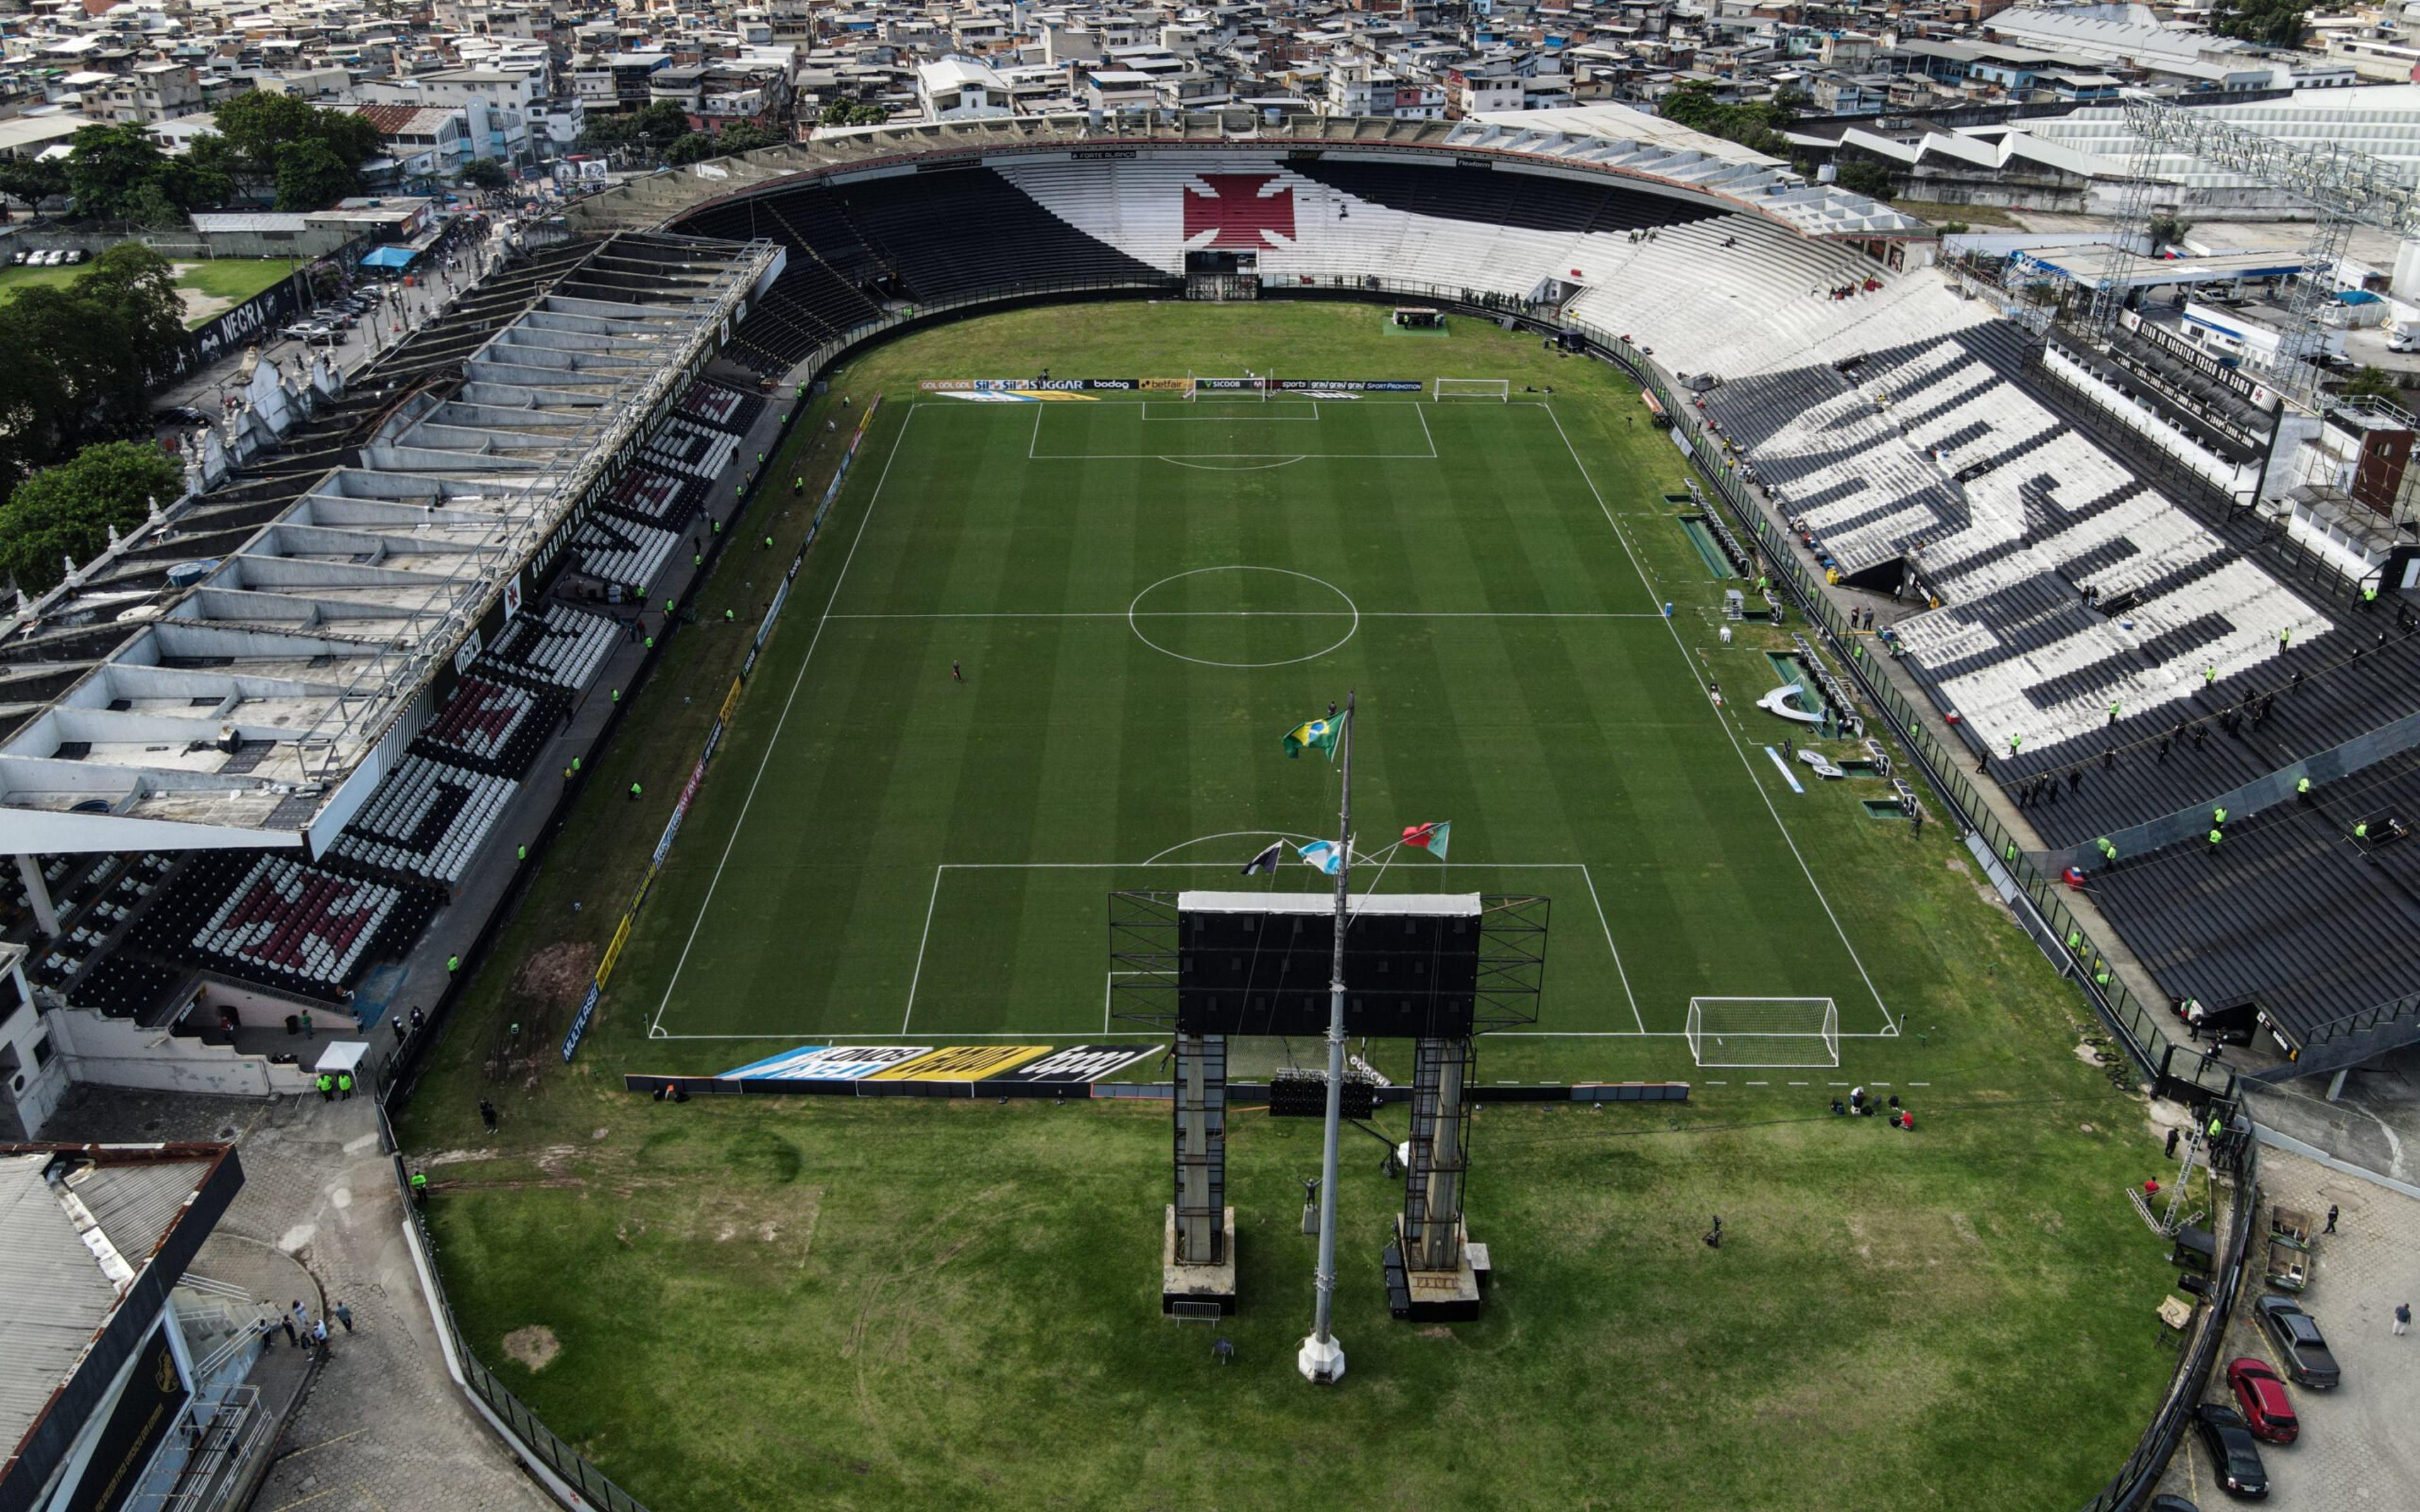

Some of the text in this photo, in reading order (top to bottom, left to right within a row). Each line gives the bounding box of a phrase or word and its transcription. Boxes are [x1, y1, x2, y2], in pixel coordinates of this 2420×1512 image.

[221, 299, 265, 344] NEGRA
[1093, 379, 1129, 389] bodog
[1151, 379, 1182, 389] betfair
[454, 627, 483, 676] VASCO
